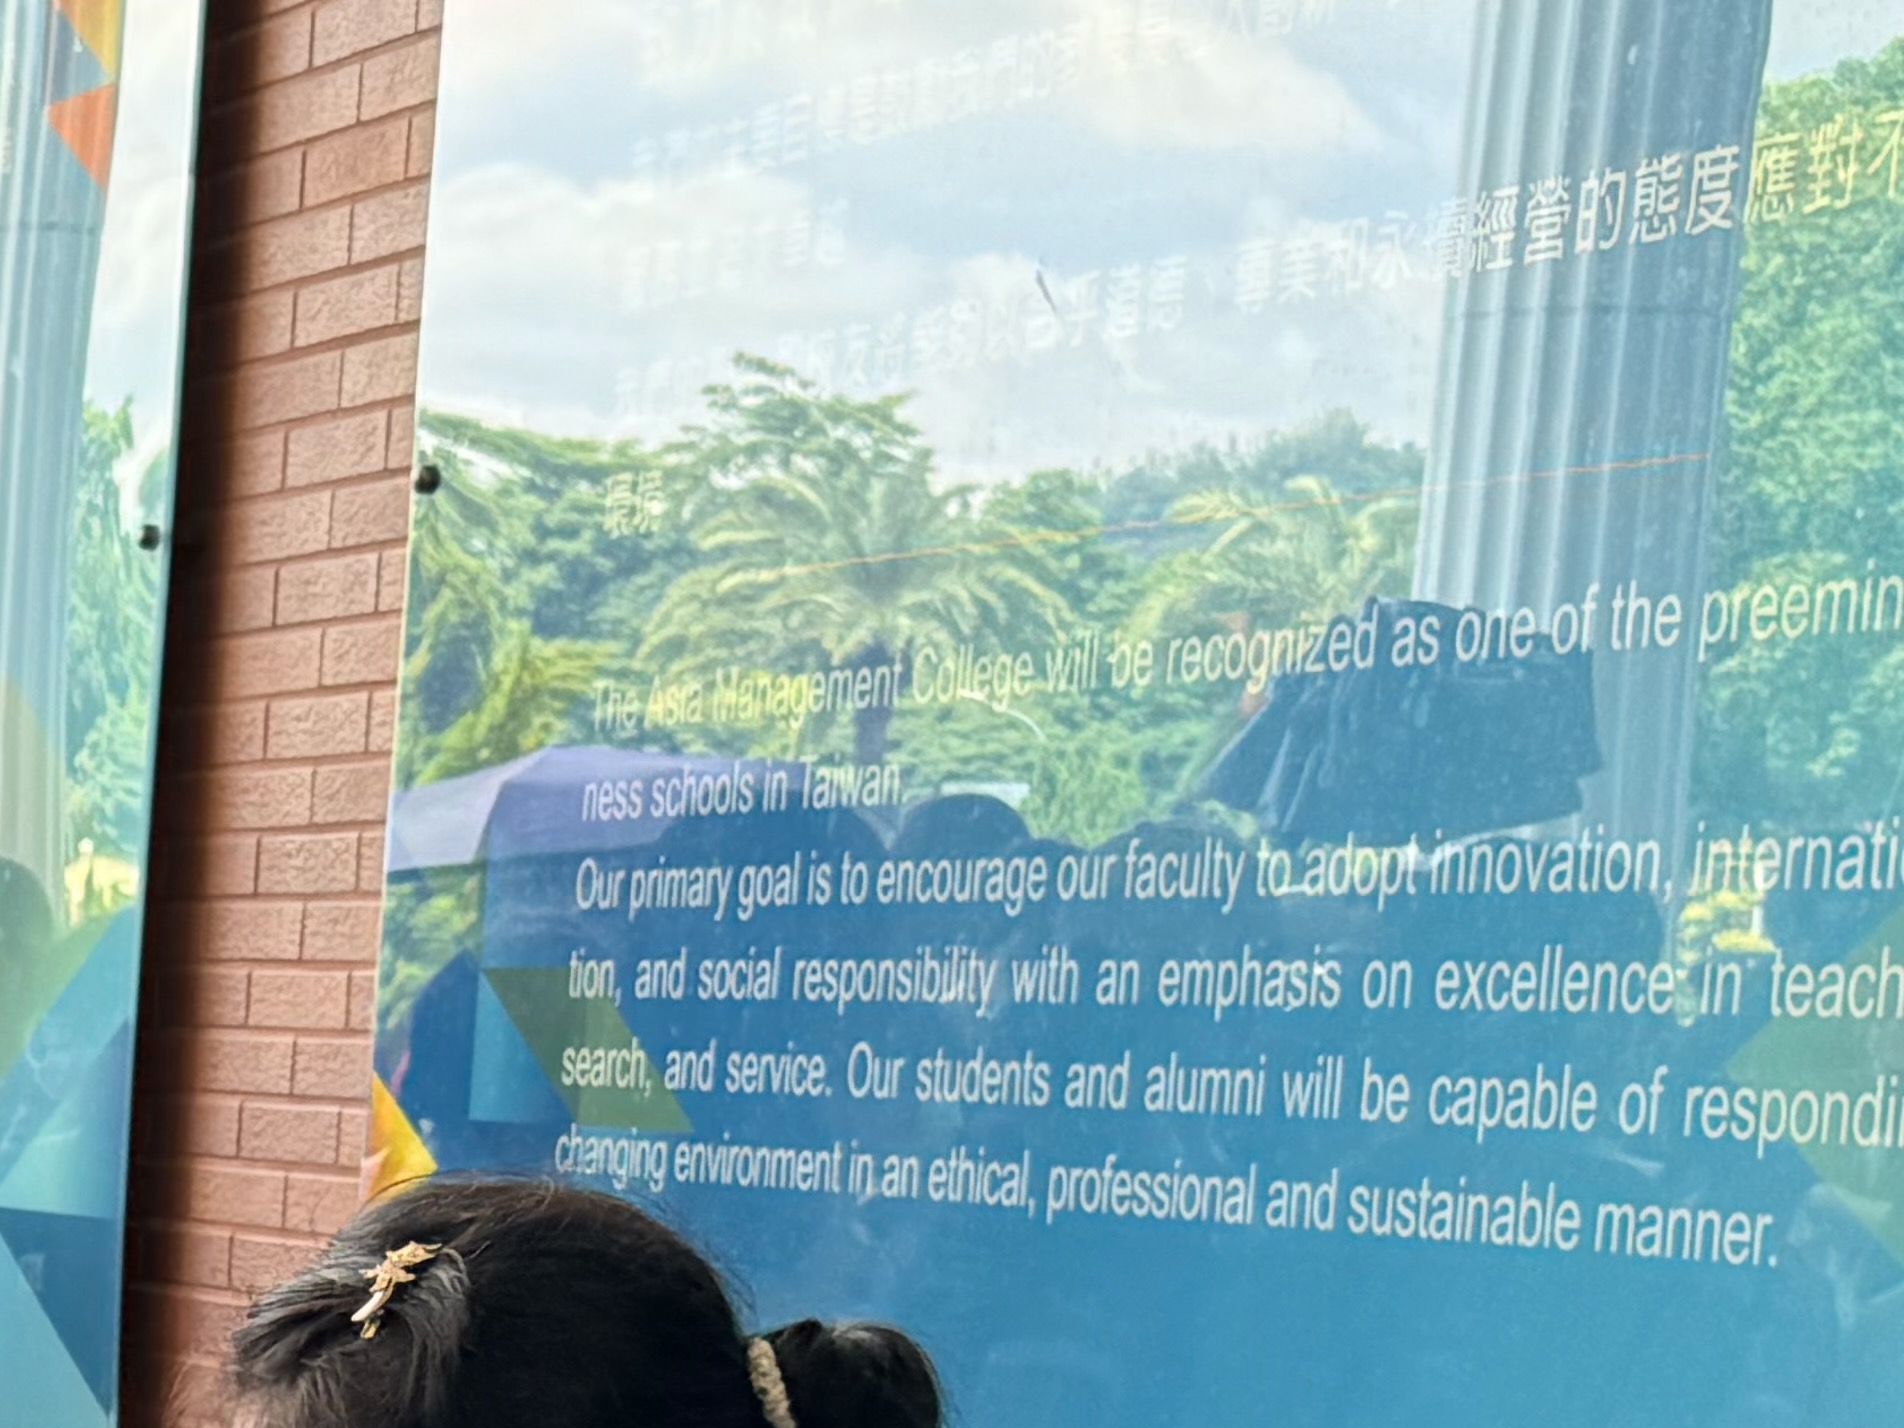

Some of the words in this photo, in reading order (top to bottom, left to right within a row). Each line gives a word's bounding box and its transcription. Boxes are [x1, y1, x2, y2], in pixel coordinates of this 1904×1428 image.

[713, 658, 902, 730] Management
[912, 645, 1035, 713] College
[1046, 630, 1099, 694] will
[1112, 634, 1154, 689] be
[1167, 598, 1378, 695] recognized
[1392, 611, 1441, 668] as
[1455, 602, 1537, 661] one
[1550, 581, 1602, 656] of
[1610, 578, 1683, 653] the
[581, 778, 643, 823] ness
[651, 763, 755, 818] schools
[763, 761, 789, 813] in
[798, 754, 906, 811] Taiwan.
[575, 857, 630, 911] Our
[630, 856, 729, 923] primary
[737, 851, 801, 922] goal
[807, 851, 833, 905] is
[840, 851, 870, 902] to
[877, 858, 1046, 918] encourage
[1057, 853, 1118, 901] our
[1125, 838, 1247, 914] faculty
[1257, 838, 1293, 898] to
[1304, 830, 1418, 912] adopt
[1430, 824, 1676, 902] innovation,
[568, 948, 623, 1007] tion,
[634, 947, 688, 1002] and
[698, 946, 782, 1002] social
[792, 945, 997, 1017] responsibility
[1011, 946, 1079, 1005] with
[1095, 957, 1140, 1007] an
[1158, 944, 1342, 1021] emphasis
[1362, 957, 1414, 1010] on
[1435, 943, 1675, 1015] excellence
[1700, 946, 1743, 1016] in
[561, 1037, 652, 1096] search,
[664, 1037, 717, 1093] and
[725, 1042, 832, 1097] service.
[846, 1040, 905, 1100] Our
[914, 1045, 1051, 1108] students
[1063, 1050, 1132, 1112] and
[1144, 1051, 1266, 1118] alumni
[1282, 1054, 1344, 1121] will
[1360, 1056, 1410, 1123] be
[1428, 1062, 1598, 1144] capable
[1618, 1065, 1670, 1136] of
[554, 1125, 668, 1190] changing
[674, 1133, 842, 1197] environment
[848, 1141, 876, 1197] in
[882, 1154, 921, 1199] an
[927, 1146, 1036, 1218] ethical,
[1047, 1154, 1258, 1225] professional
[1265, 1167, 1340, 1232] and
[1346, 1176, 1583, 1251] sustainable
[1594, 1203, 1780, 1268] manner.
